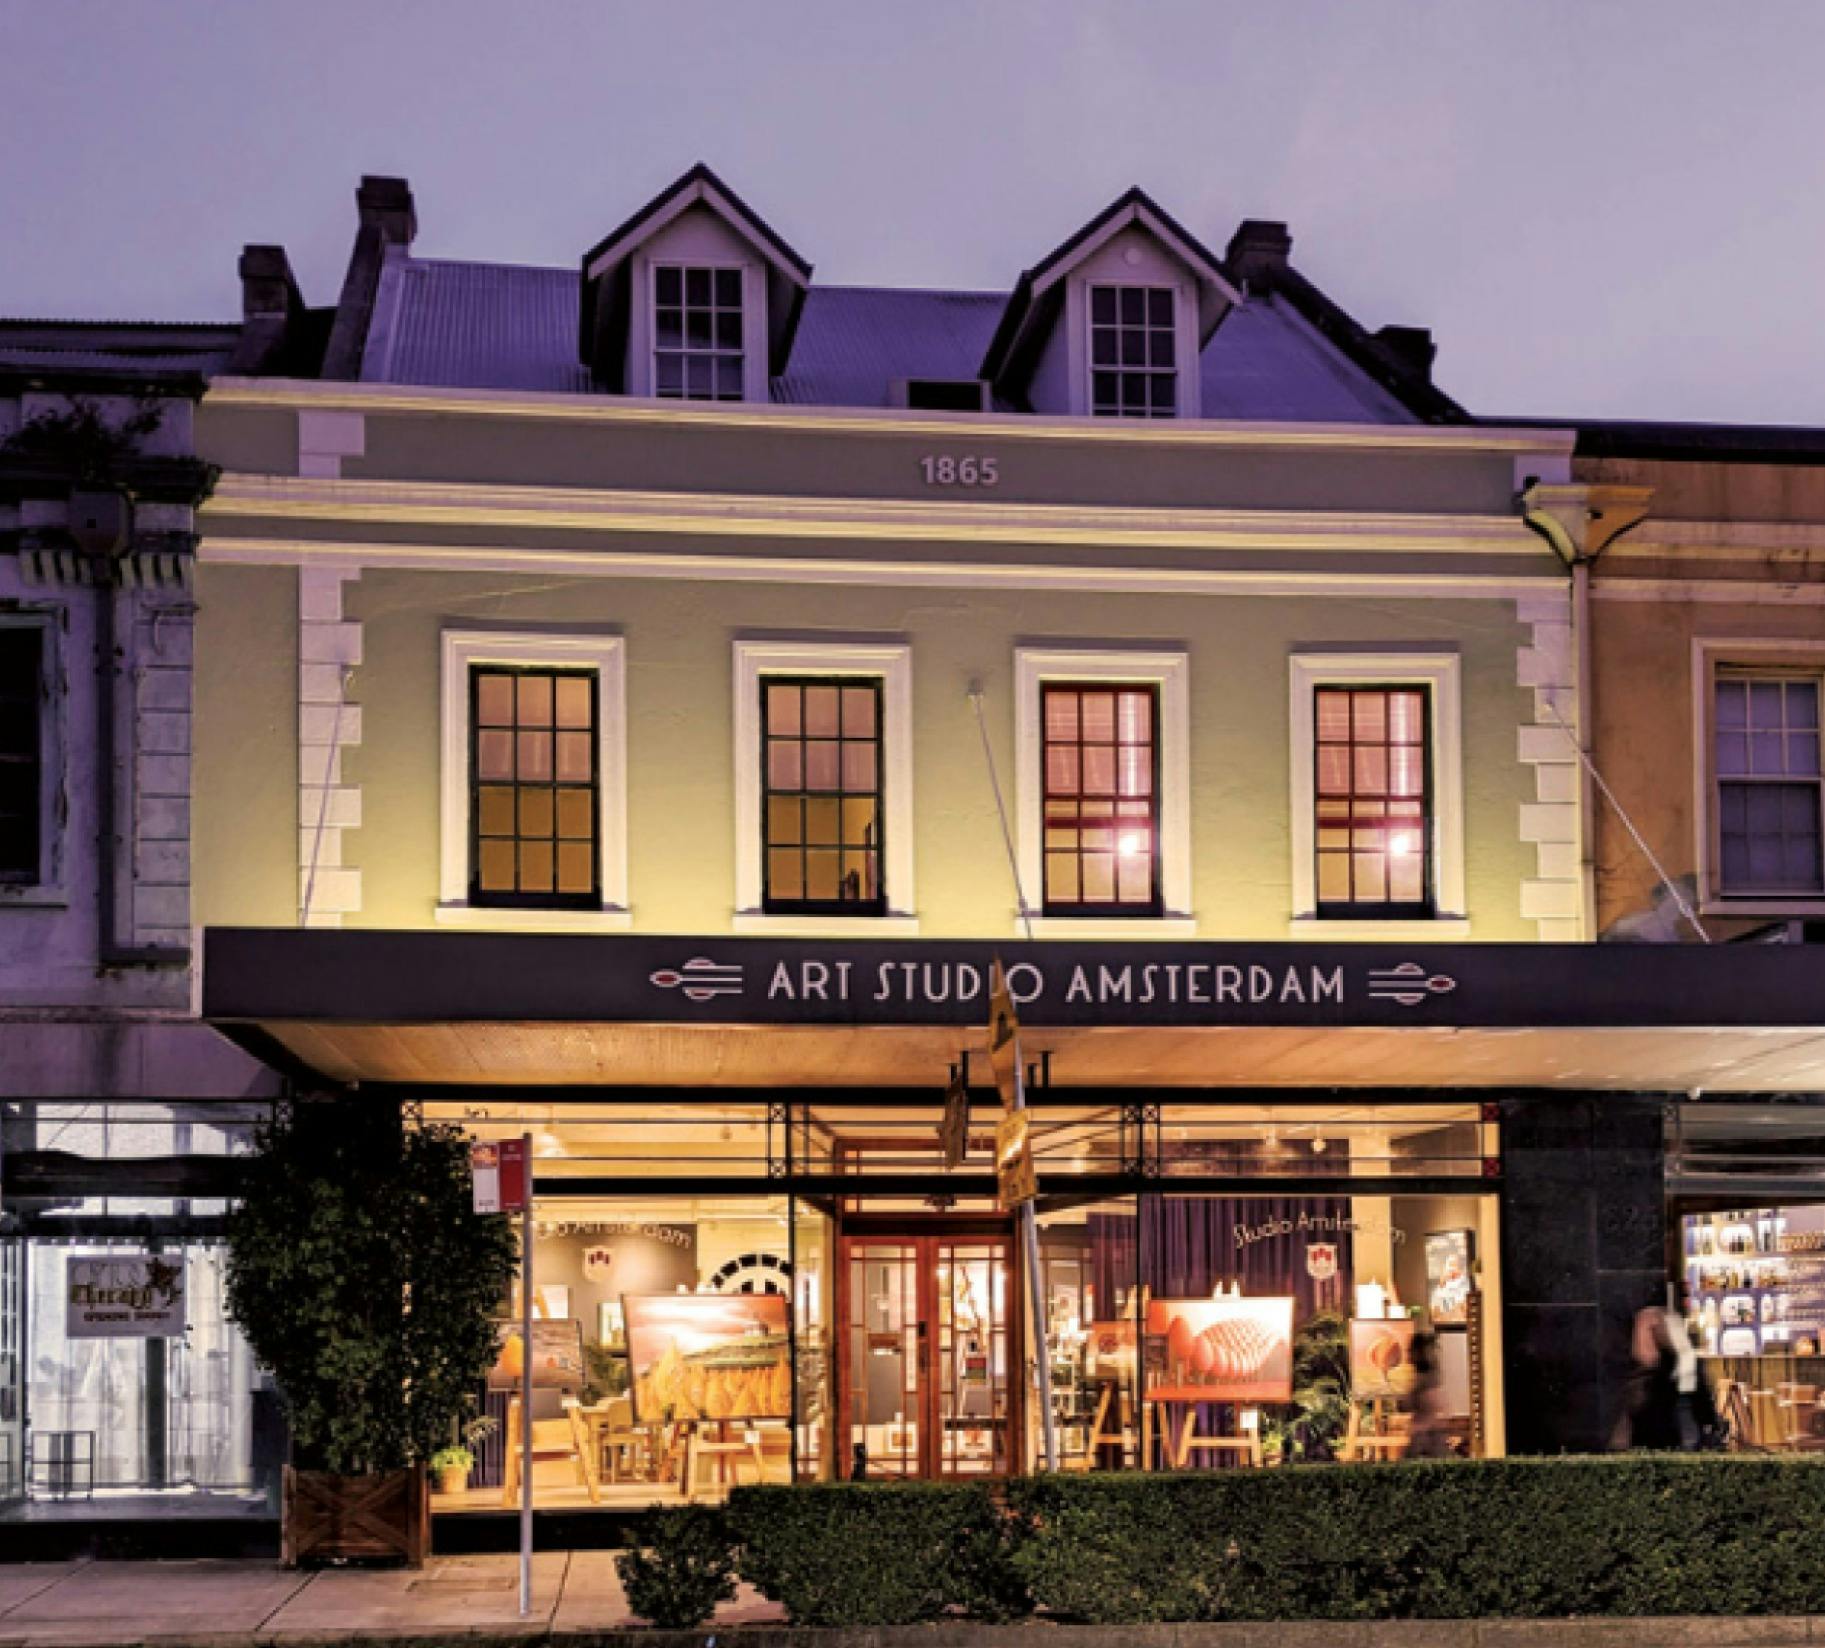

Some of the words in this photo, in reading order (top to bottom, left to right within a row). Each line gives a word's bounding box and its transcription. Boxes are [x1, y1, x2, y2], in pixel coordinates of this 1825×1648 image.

[920, 456, 999, 485] 1865
[767, 959, 852, 1001] ART
[1065, 963, 1345, 1004] AMSTERDAM
